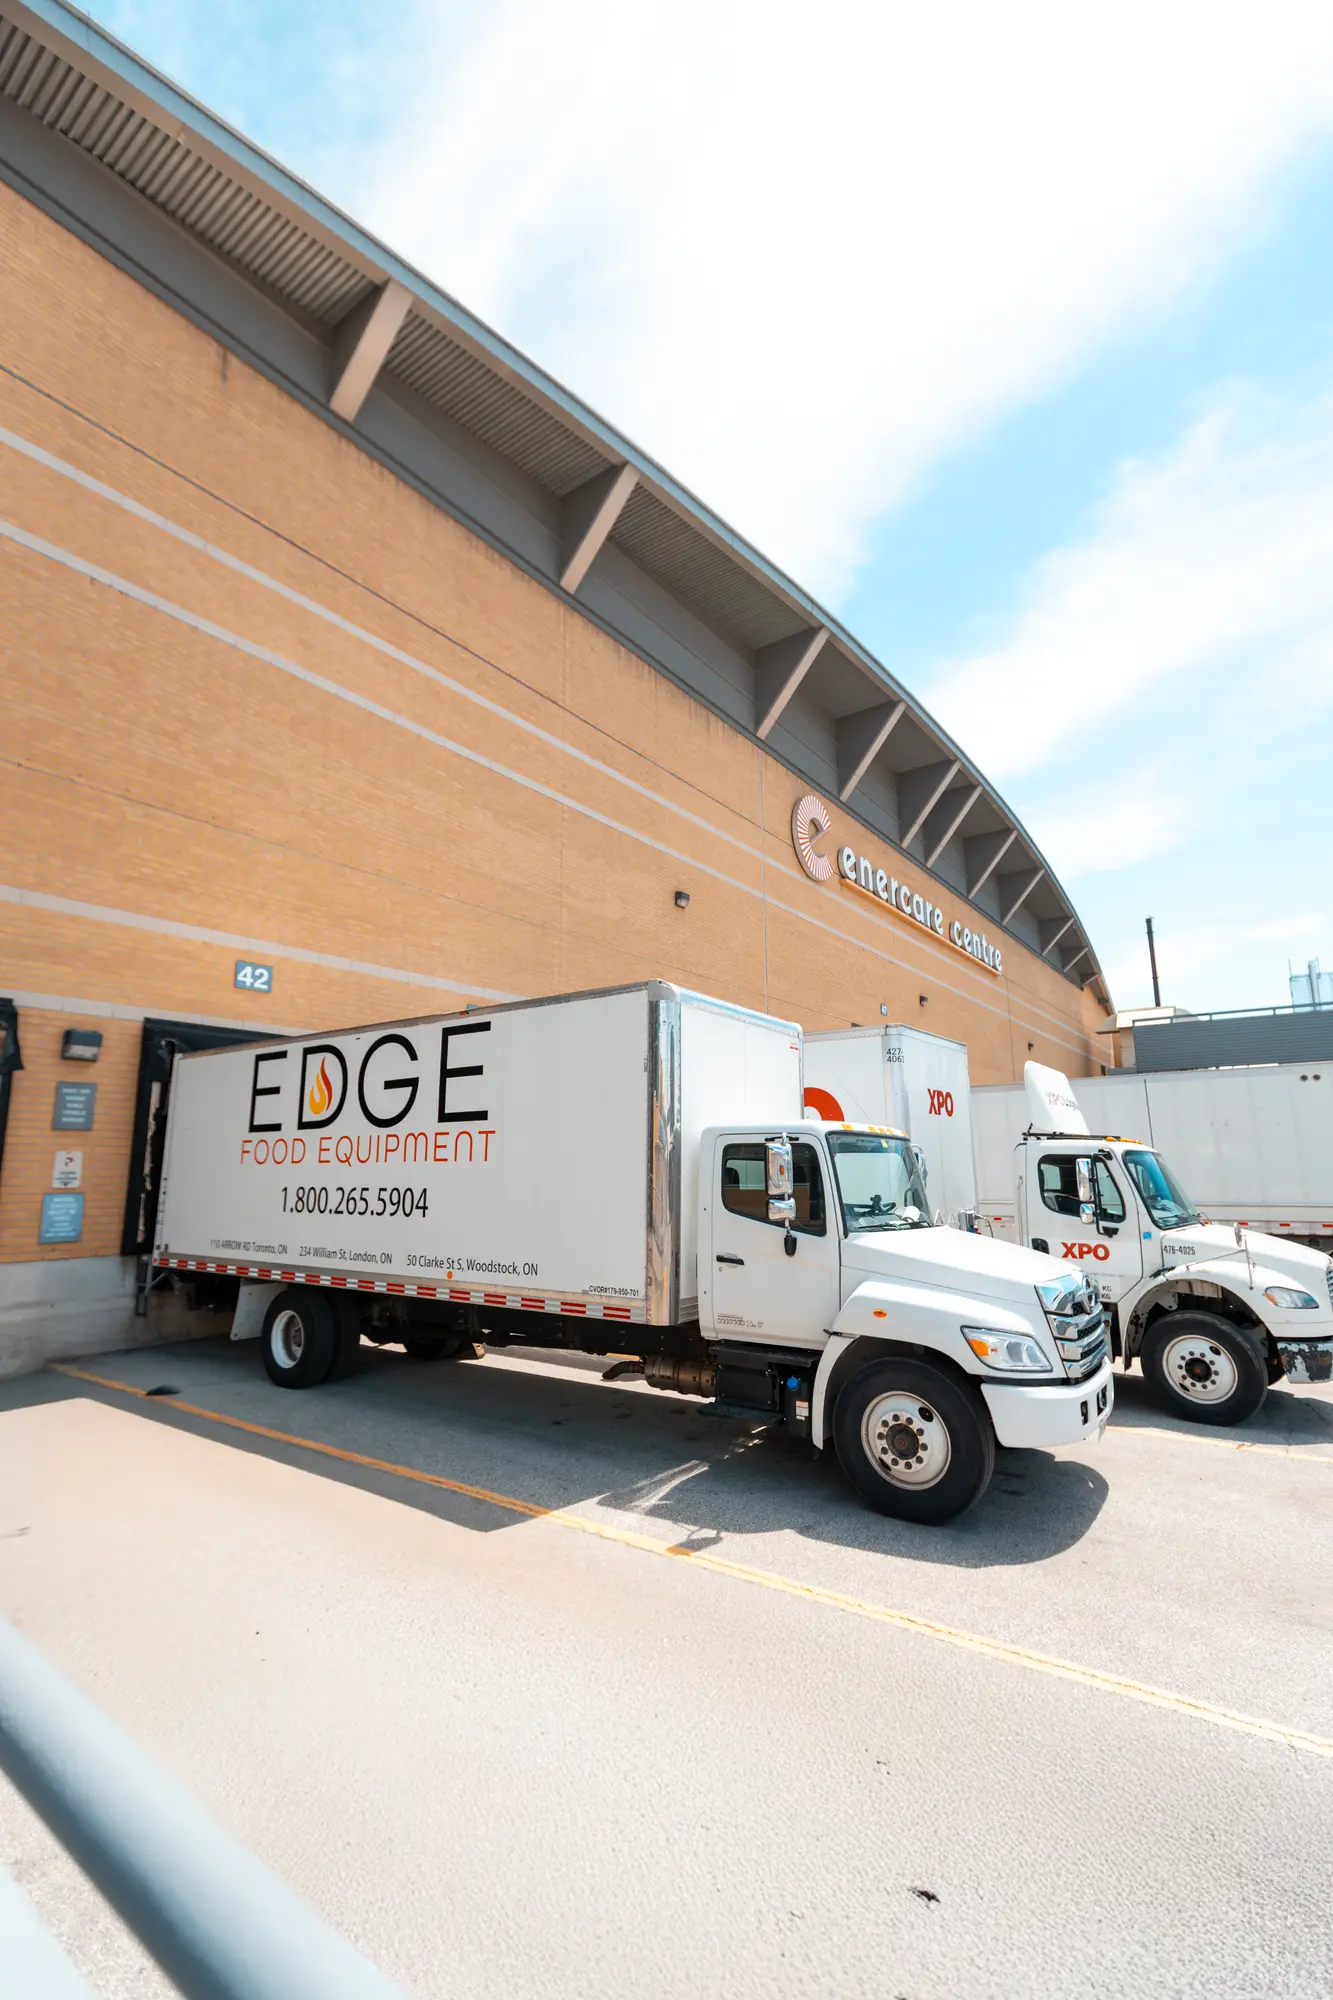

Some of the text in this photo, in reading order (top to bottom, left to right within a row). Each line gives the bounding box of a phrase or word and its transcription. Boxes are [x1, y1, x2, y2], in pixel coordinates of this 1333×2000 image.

[837, 846, 1003, 972] enercare centre
[237, 966, 269, 990] 42
[248, 1020, 492, 1133] EDGE
[927, 1088, 954, 1117] XPO
[240, 1130, 496, 1167] FOOD EQUIPMENT
[280, 1186, 429, 1218] 1.800.265.5904
[220, 1239, 242, 1251] ARROW
[242, 1241, 251, 1252] RD
[277, 1244, 288, 1255] ON
[299, 1246, 393, 1265] 234 William St, London, ON
[1060, 1241, 1111, 1262] XPO
[1163, 1245, 1196, 1256] 476-4025
[406, 1254, 539, 1277] 50 Clarke St S, Woodstock, ON
[588, 1284, 640, 1298] CVOR#179-950-701
[1102, 1285, 1112, 1293] KG
